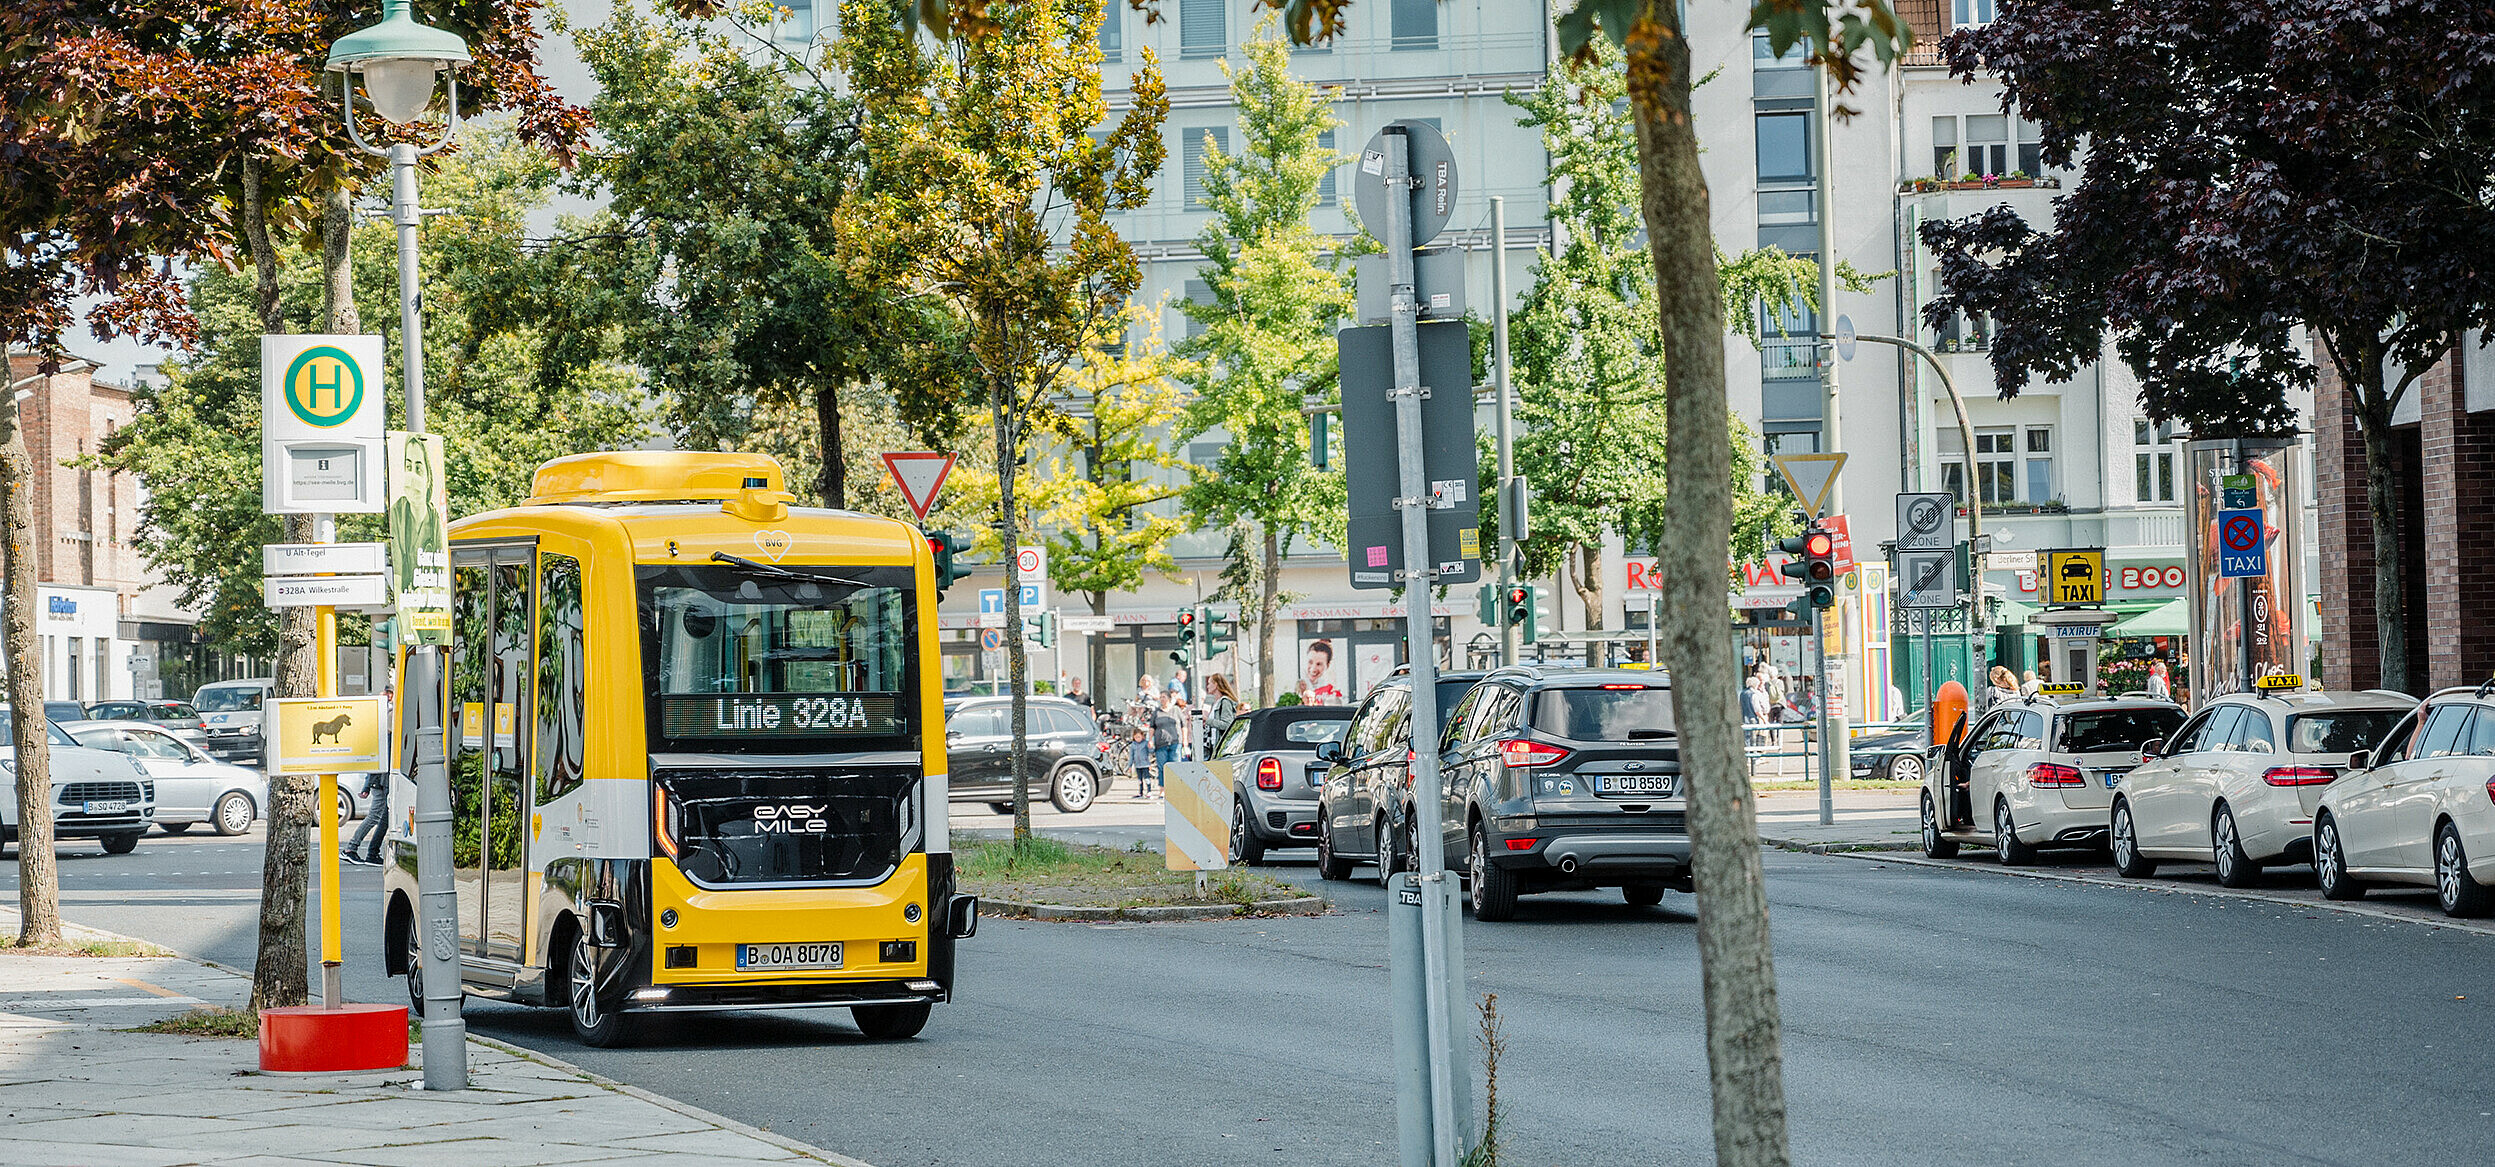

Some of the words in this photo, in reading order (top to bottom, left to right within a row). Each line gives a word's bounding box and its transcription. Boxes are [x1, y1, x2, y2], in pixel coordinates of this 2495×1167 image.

[1438, 162, 1447, 186] TBA
[309, 364, 341, 409] H
[765, 538, 783, 548] BVG
[1913, 537, 1939, 547] ZONE
[286, 549, 291, 557] U
[293, 549, 326, 558] Alt-Tegel
[1021, 556, 1035, 567] 30
[2224, 556, 2261, 572] TAXI
[285, 587, 305, 595] 328A
[308, 585, 350, 594] Wilkestraße
[2061, 585, 2094, 601] TAXI
[1023, 588, 1034, 604] P
[1914, 595, 1941, 605] ZONE
[1292, 607, 1361, 618] ROSSMANN
[2056, 626, 2099, 636] TAXIRUF
[2268, 677, 2297, 685] TAXI
[717, 698, 780, 729] Linie
[793, 697, 868, 729] 328A
[1603, 778, 1611, 789] B
[1620, 777, 1636, 789] CD
[1640, 777, 1670, 789] 8589
[2112, 775, 2119, 784] B
[88, 802, 94, 811] B
[1400, 892, 1422, 904] TBA
[748, 947, 758, 964] B
[771, 946, 793, 963] OA
[797, 944, 840, 963] 8078
